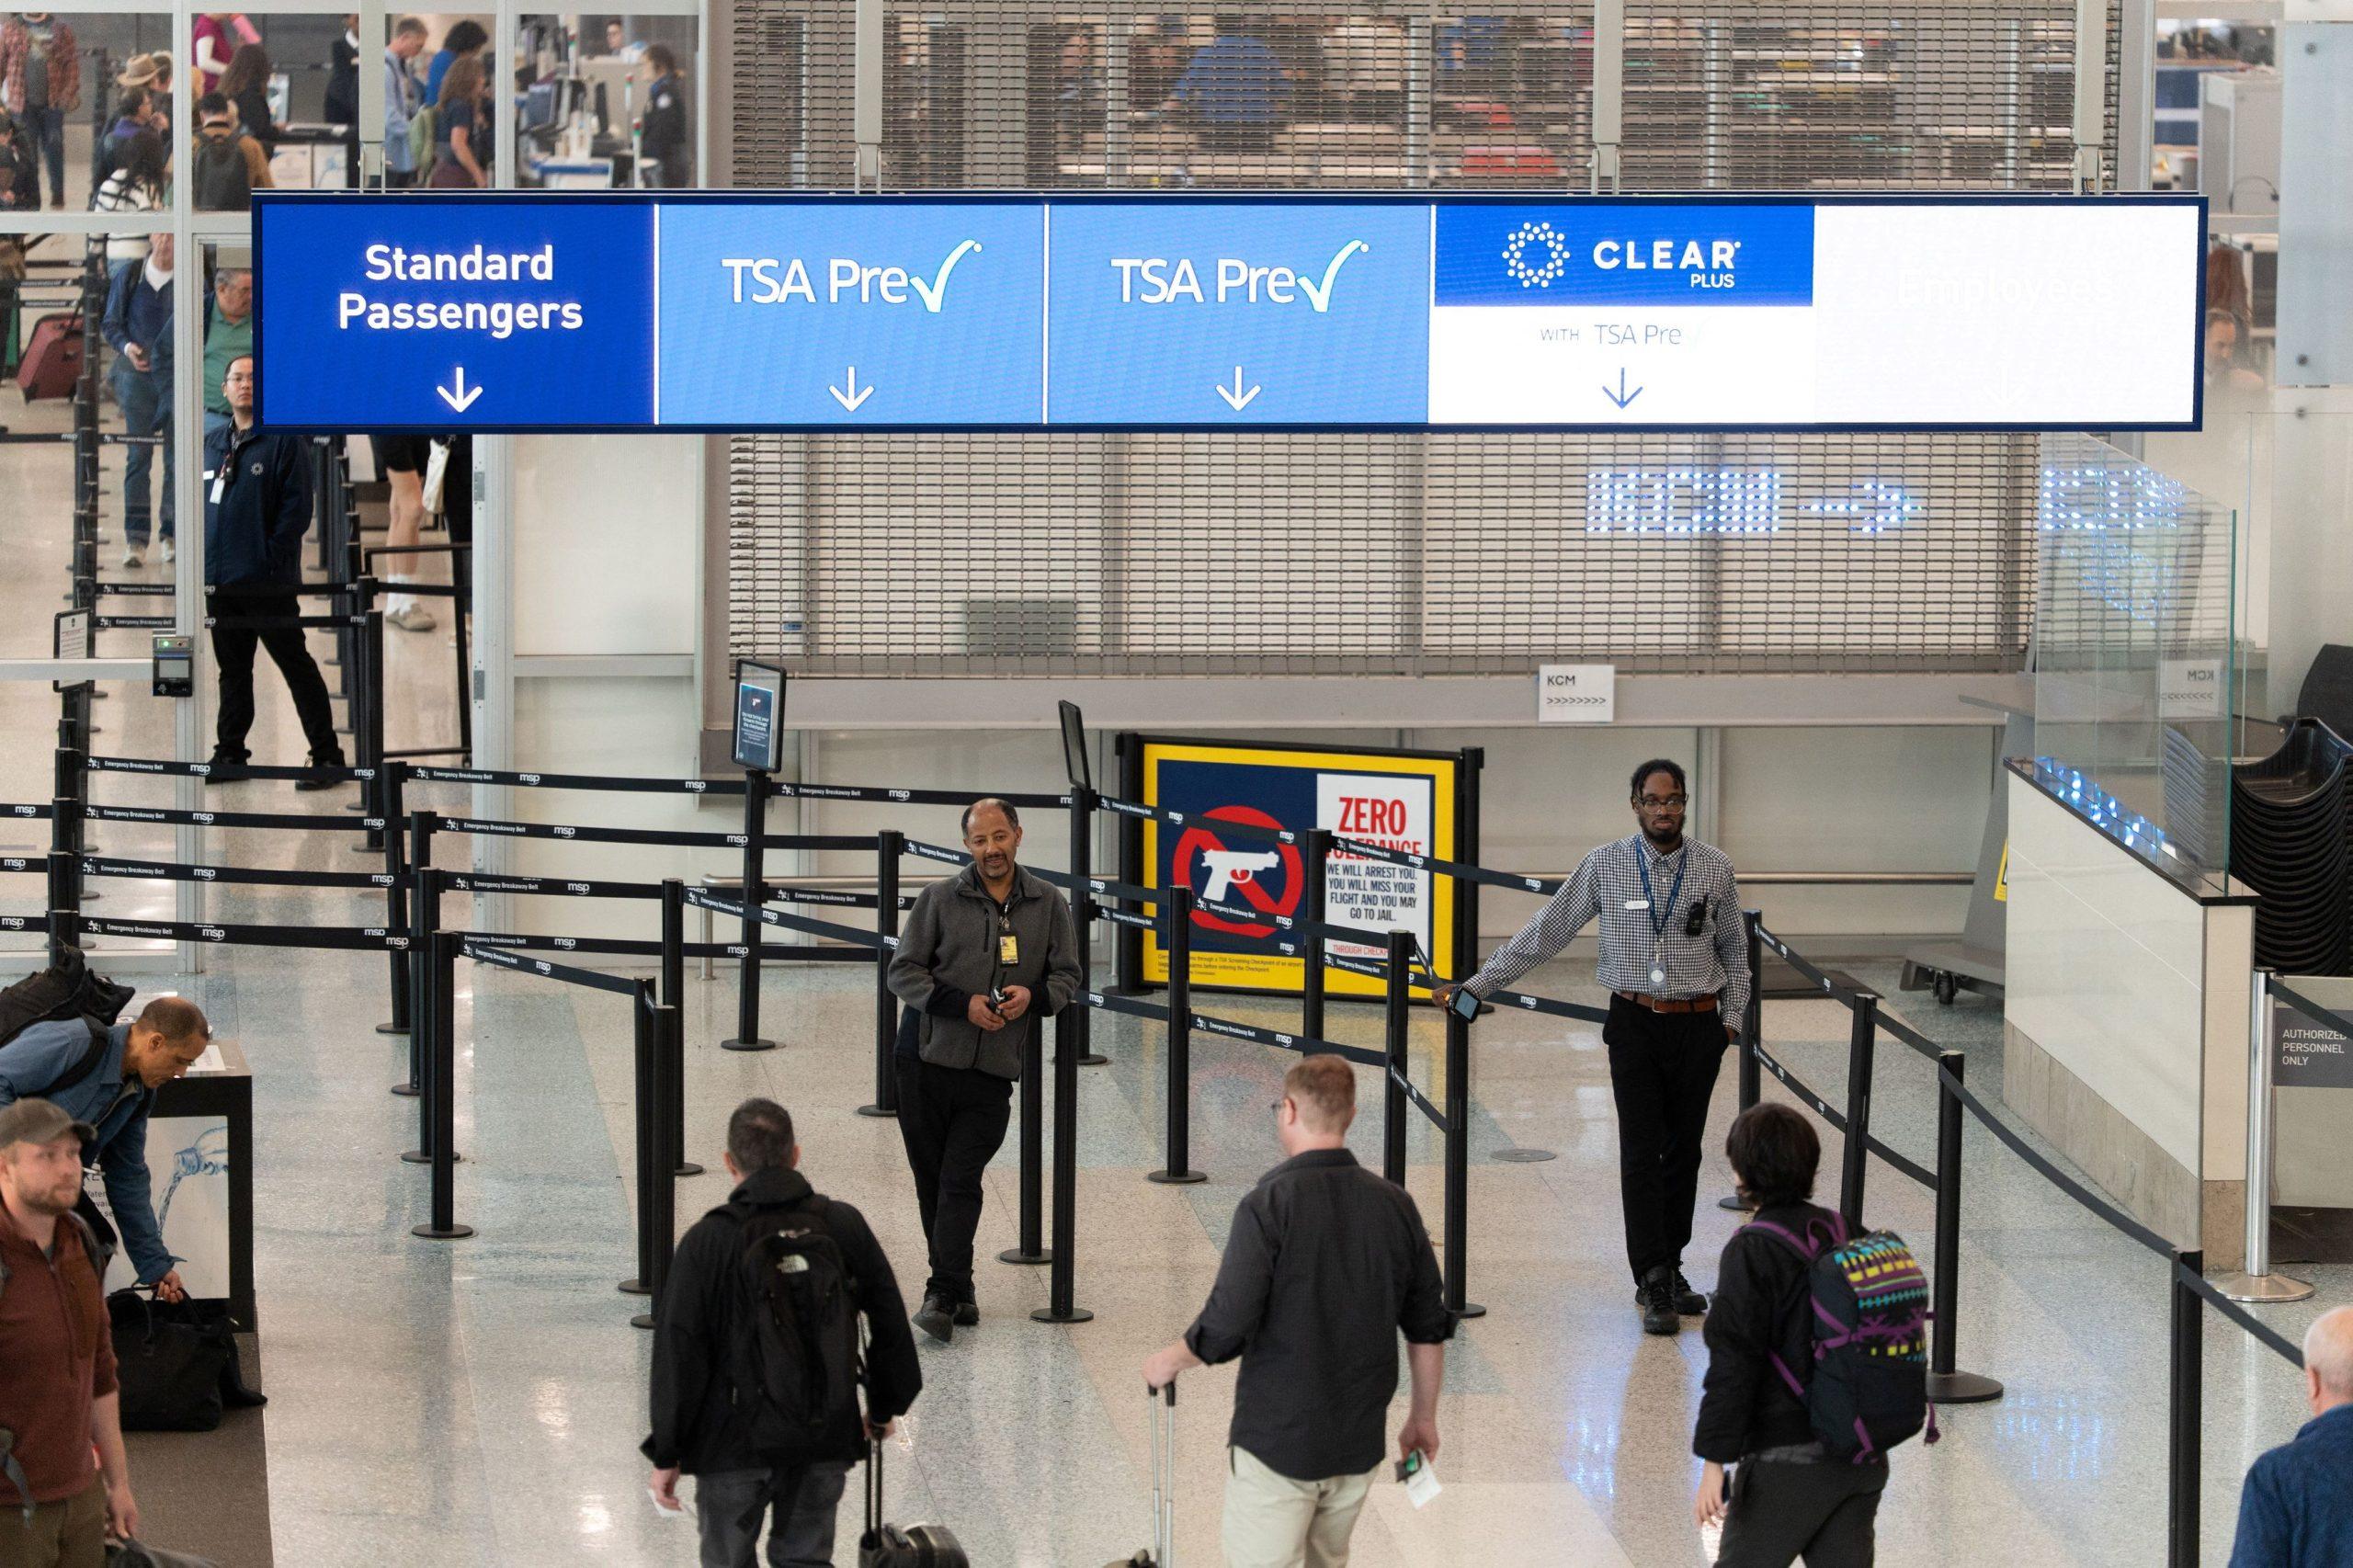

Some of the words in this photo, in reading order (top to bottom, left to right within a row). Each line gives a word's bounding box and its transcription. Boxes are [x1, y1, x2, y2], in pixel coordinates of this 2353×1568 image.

[1593, 240, 1735, 269] CLEAR
[365, 244, 553, 281] Standard
[722, 258, 817, 304] TSA
[829, 258, 909, 304] Pre
[1110, 258, 1204, 304] TSA
[1217, 258, 1296, 304] Pre
[1690, 273, 1735, 289] PLUS
[339, 292, 584, 339] Passengers
[1540, 328, 1580, 342] WITH
[1594, 324, 1637, 346] TSA
[1644, 324, 1682, 346] Pre
[204, 585, 215, 596] sp
[204, 618, 217, 627] sp
[1547, 675, 1575, 686] KCM
[104, 760, 128, 768] Emergency
[130, 762, 153, 770] Breakaway
[190, 764, 211, 776] msp
[355, 768, 375, 779] msp
[520, 774, 540, 785] msp
[686, 781, 706, 792] msp
[889, 789, 910, 801] msp
[1061, 796, 1073, 804] ms
[15, 805, 36, 817] msp
[103, 809, 128, 817] Emergency
[130, 811, 153, 819] Breakaway
[1169, 811, 1184, 824] msp
[1338, 796, 1406, 836] ZERO
[193, 812, 214, 824] msp
[364, 818, 385, 830] msp
[463, 822, 488, 830] Emergency
[490, 824, 515, 832] Breakaway
[553, 826, 575, 838] msp
[727, 835, 748, 847] msp
[1279, 831, 1294, 844] msp
[4, 858, 26, 870] msp
[1409, 855, 1424, 868] msp
[194, 869, 216, 881] msp
[1327, 864, 1339, 876] WE
[1343, 864, 1362, 877] WILL
[1365, 867, 1396, 879] ARREST
[1399, 868, 1417, 881] YOU.
[372, 875, 394, 886] msp
[501, 881, 527, 890] Breakaway
[1090, 880, 1105, 893] msp
[1328, 877, 1344, 891] YOU
[1347, 879, 1368, 892] WILL
[1370, 881, 1392, 892] MISS
[1393, 881, 1415, 894] YOUR
[1526, 879, 1541, 892] msp
[568, 882, 590, 895] msp
[794, 892, 819, 900] Emergency
[820, 893, 845, 902] Breakaway
[1330, 892, 1358, 905] FLIGHT
[1360, 894, 1379, 906] AND
[1381, 895, 1397, 908] YOU
[1399, 896, 1417, 908] MAY
[763, 910, 779, 924] msp
[1349, 907, 1362, 919] GO
[1364, 908, 1375, 920] TO
[1377, 909, 1397, 922] JAIL.
[2, 917, 24, 930] msp
[1276, 915, 1292, 929] msp
[107, 924, 133, 932] Emergency
[134, 926, 161, 934] Breakaway
[202, 928, 225, 941] msp
[386, 936, 409, 949] msp
[464, 935, 489, 943] Emergency
[555, 937, 576, 950] msp
[884, 936, 900, 950] msp
[728, 946, 749, 958] msp
[1279, 942, 1295, 956] msp
[536, 960, 551, 974] msp
[1089, 993, 1104, 1007] msp
[1520, 995, 1537, 1009] msp
[1276, 1033, 1292, 1048] msp
[2283, 1042, 2345, 1054] PERSONNEL
[2282, 1056, 2309, 1066] ONLY
